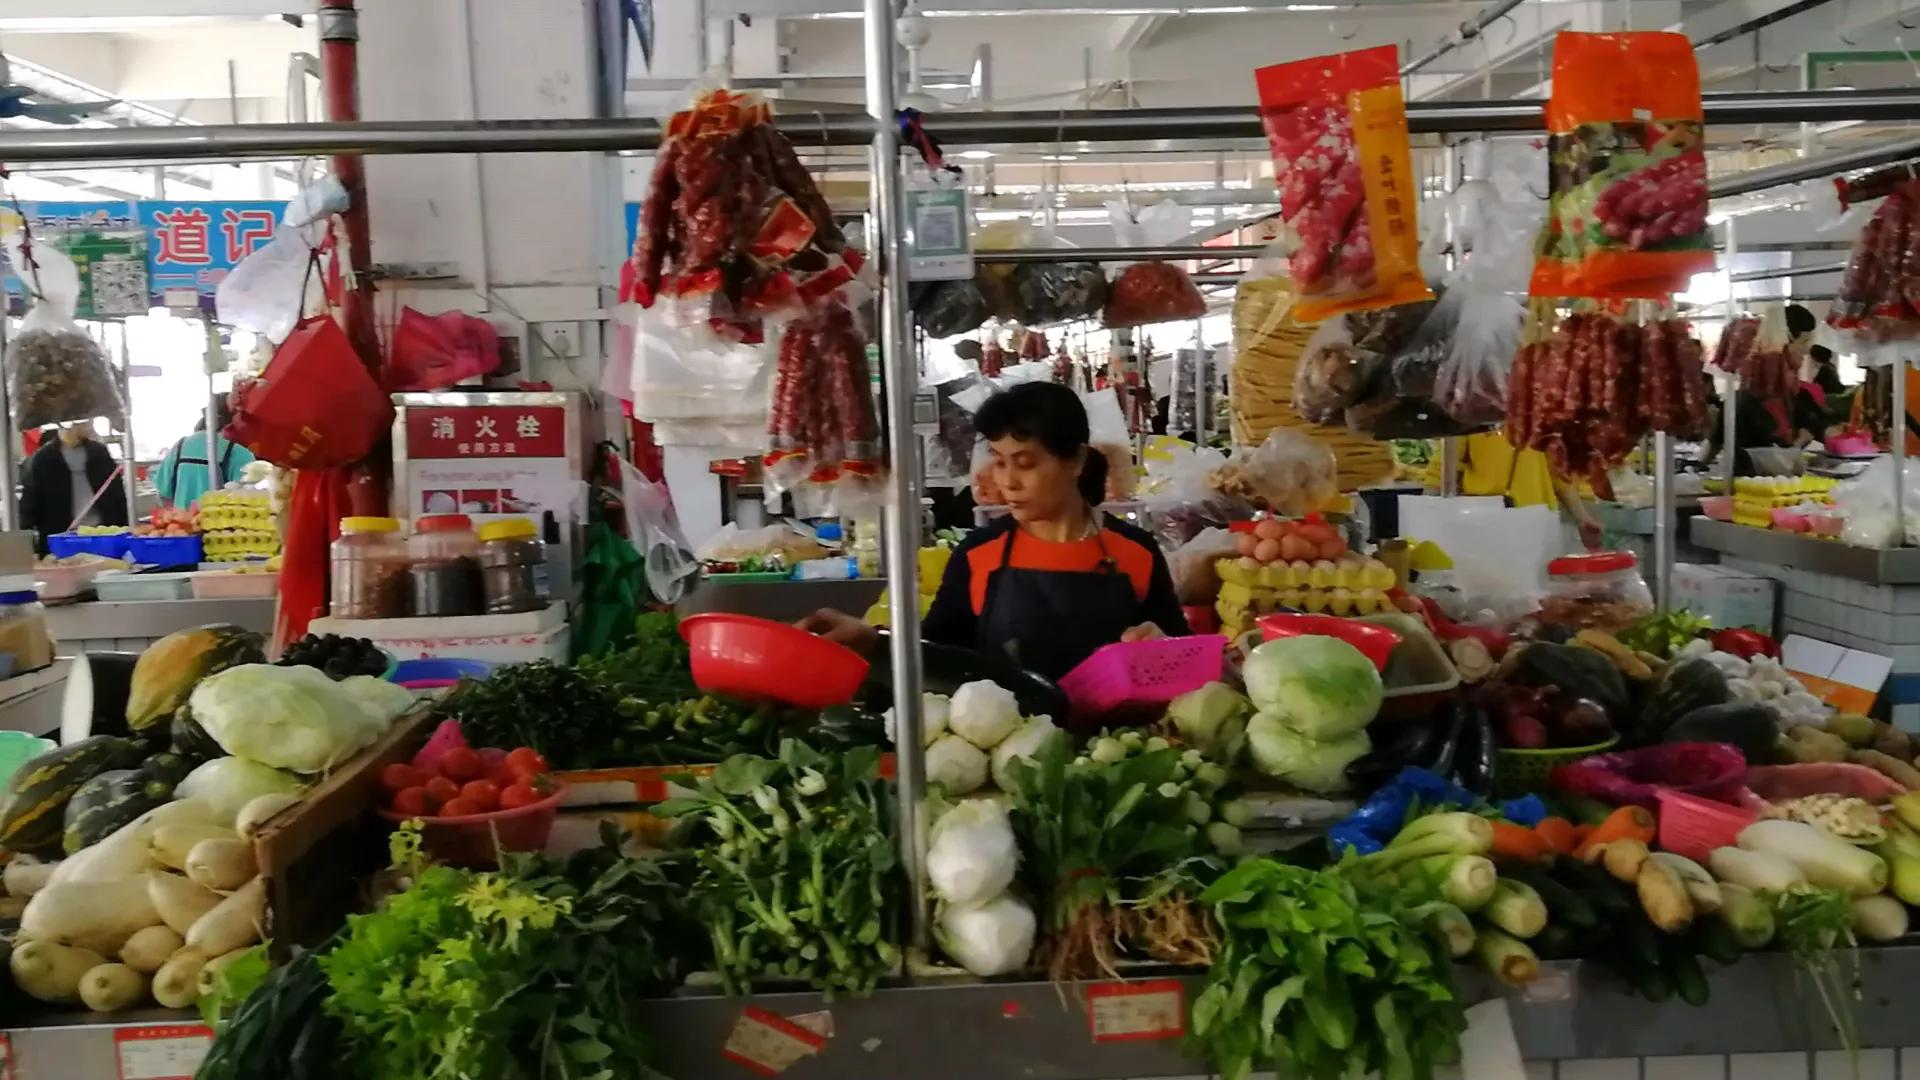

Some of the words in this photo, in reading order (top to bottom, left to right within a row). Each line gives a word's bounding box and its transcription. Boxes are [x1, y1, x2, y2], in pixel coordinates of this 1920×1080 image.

[154, 208, 276, 264] 道记
[431, 415, 541, 439] 消火栓
